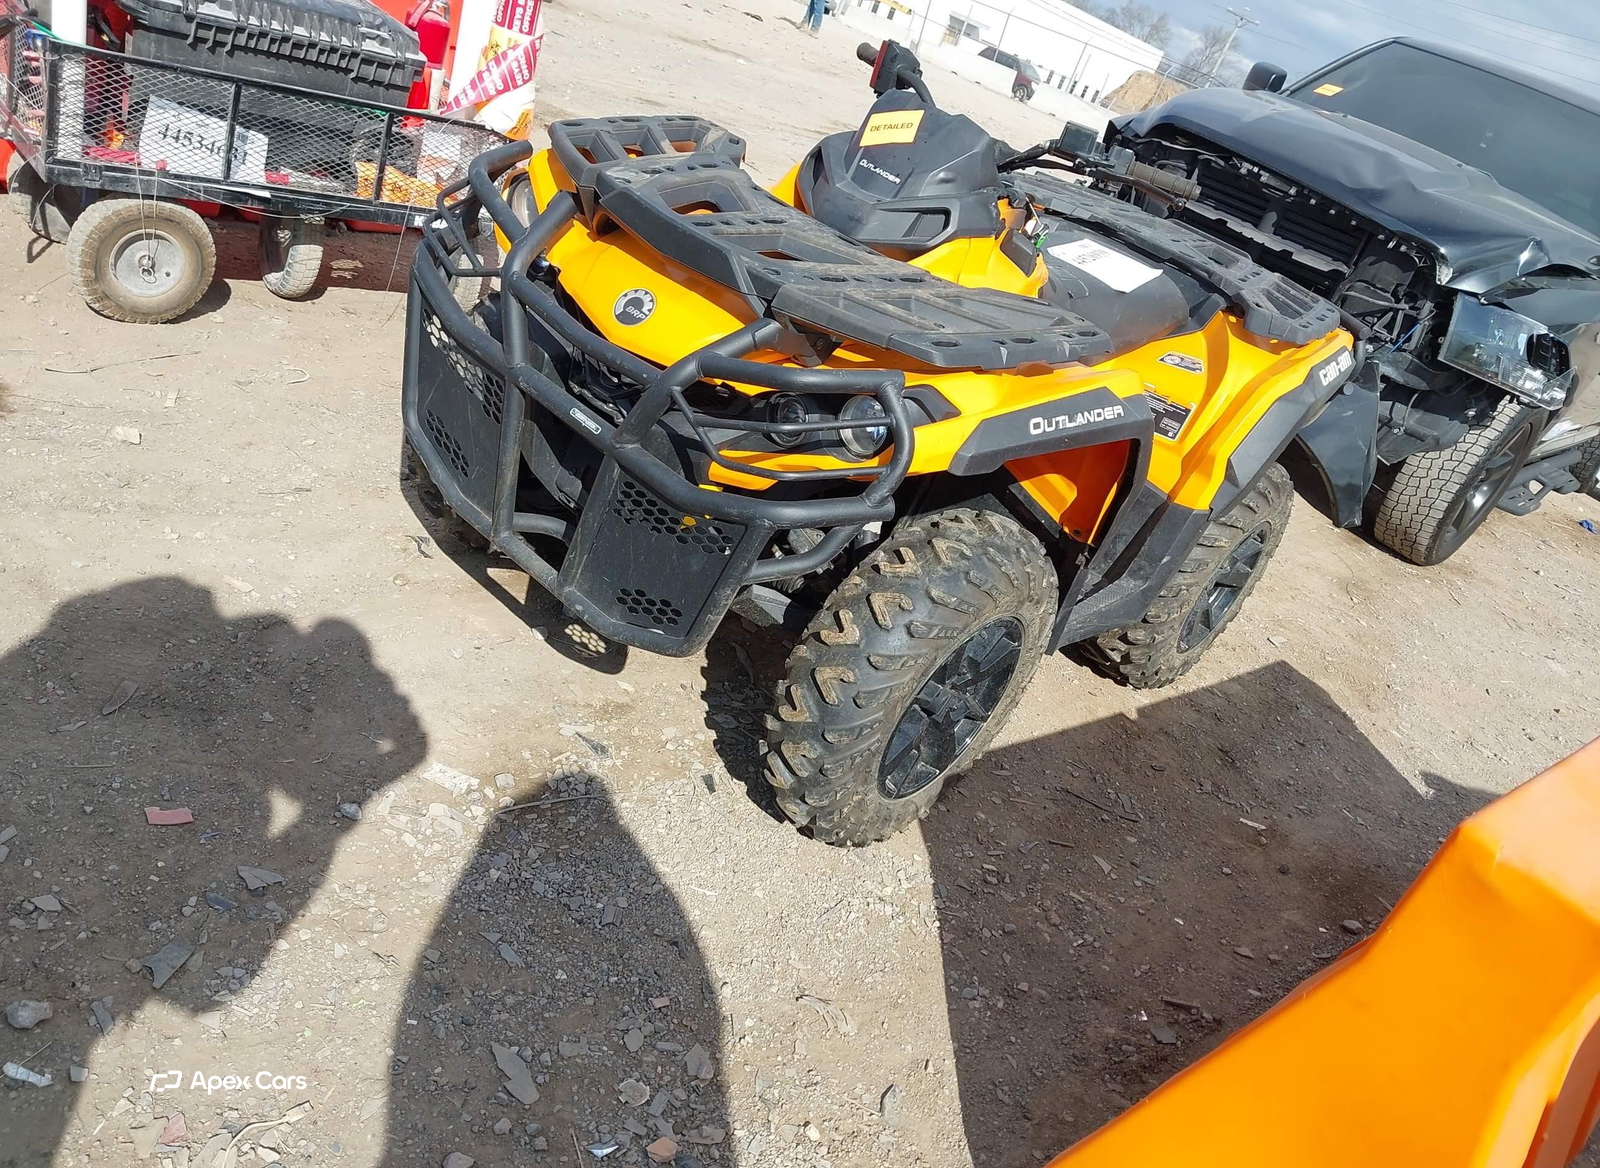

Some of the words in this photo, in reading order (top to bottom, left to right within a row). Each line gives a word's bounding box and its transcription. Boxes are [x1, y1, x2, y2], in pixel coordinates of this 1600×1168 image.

[870, 122, 914, 132] DETAILED
[859, 159, 901, 185] OUTLANDER
[625, 305, 646, 319] BRP
[1318, 350, 1353, 387] can-am
[1029, 404, 1125, 435] OUTLANDER
